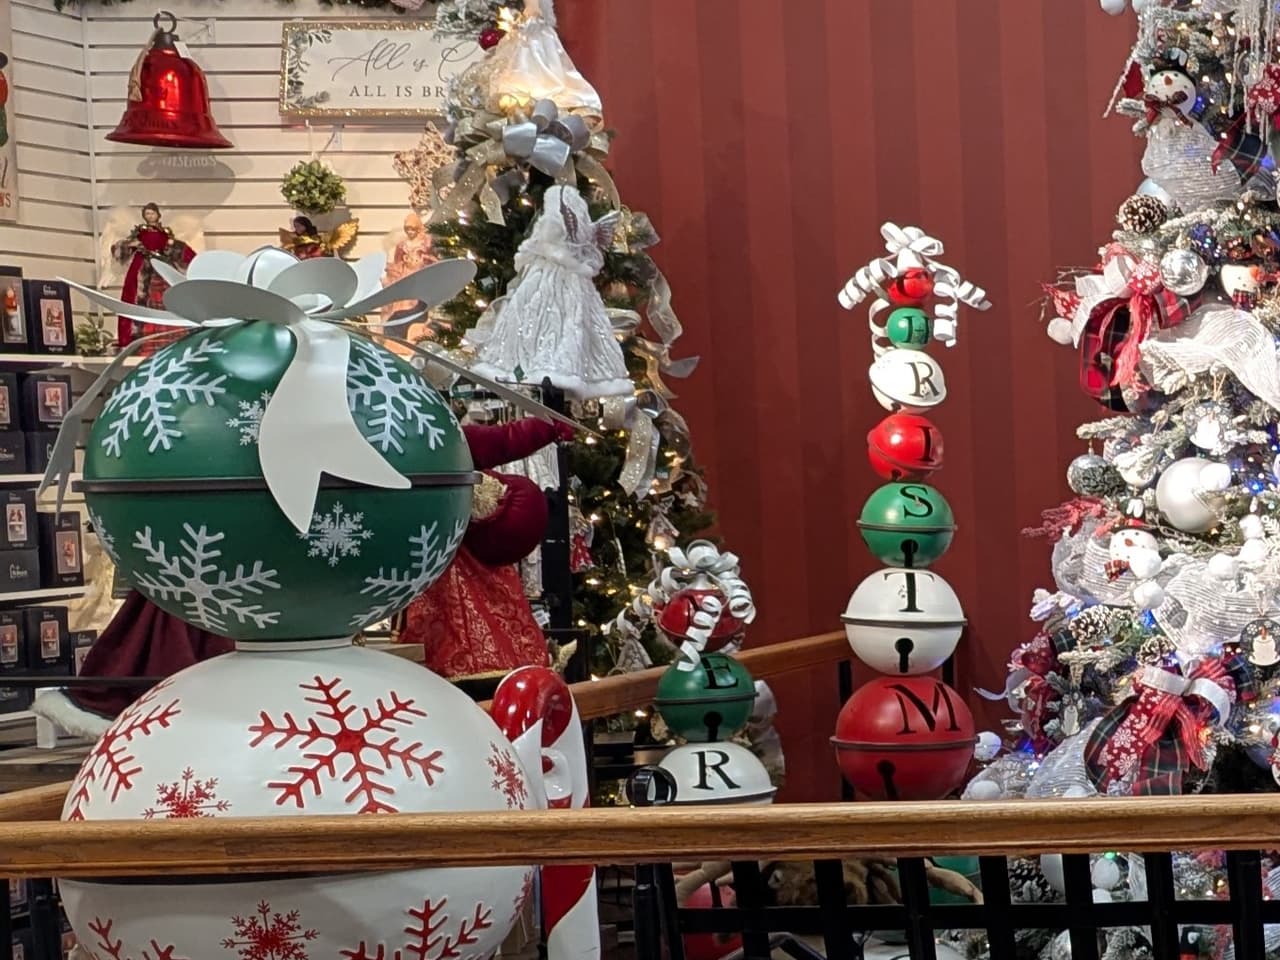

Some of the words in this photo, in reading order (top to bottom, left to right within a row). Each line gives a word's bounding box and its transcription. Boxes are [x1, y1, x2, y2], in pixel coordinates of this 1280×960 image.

[327, 38, 411, 81] All
[413, 58, 428, 72] is
[349, 86, 386, 97] ALL
[396, 86, 412, 97] IS
